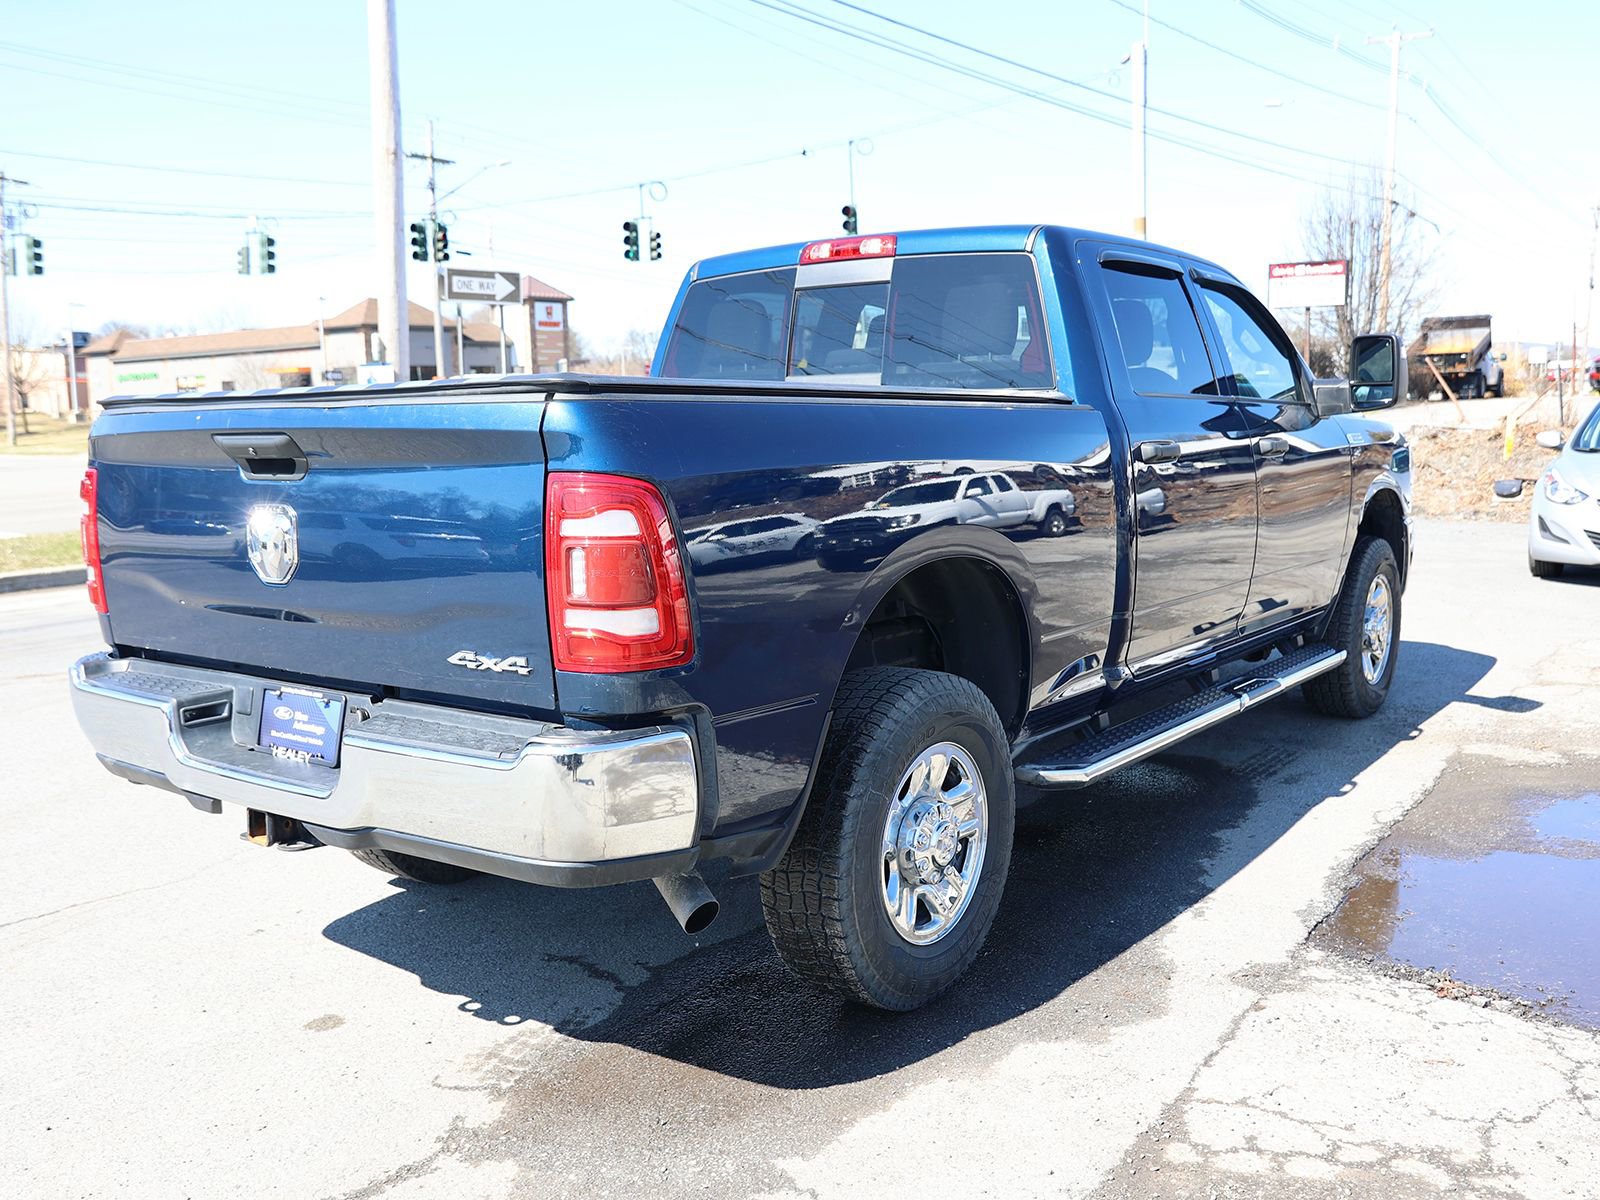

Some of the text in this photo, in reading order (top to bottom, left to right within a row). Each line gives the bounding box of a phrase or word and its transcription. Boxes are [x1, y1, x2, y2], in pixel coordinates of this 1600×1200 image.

[456, 279, 497, 292] ONE WAY
[447, 650, 534, 675] 4x4
[272, 745, 312, 766] HEALEY
